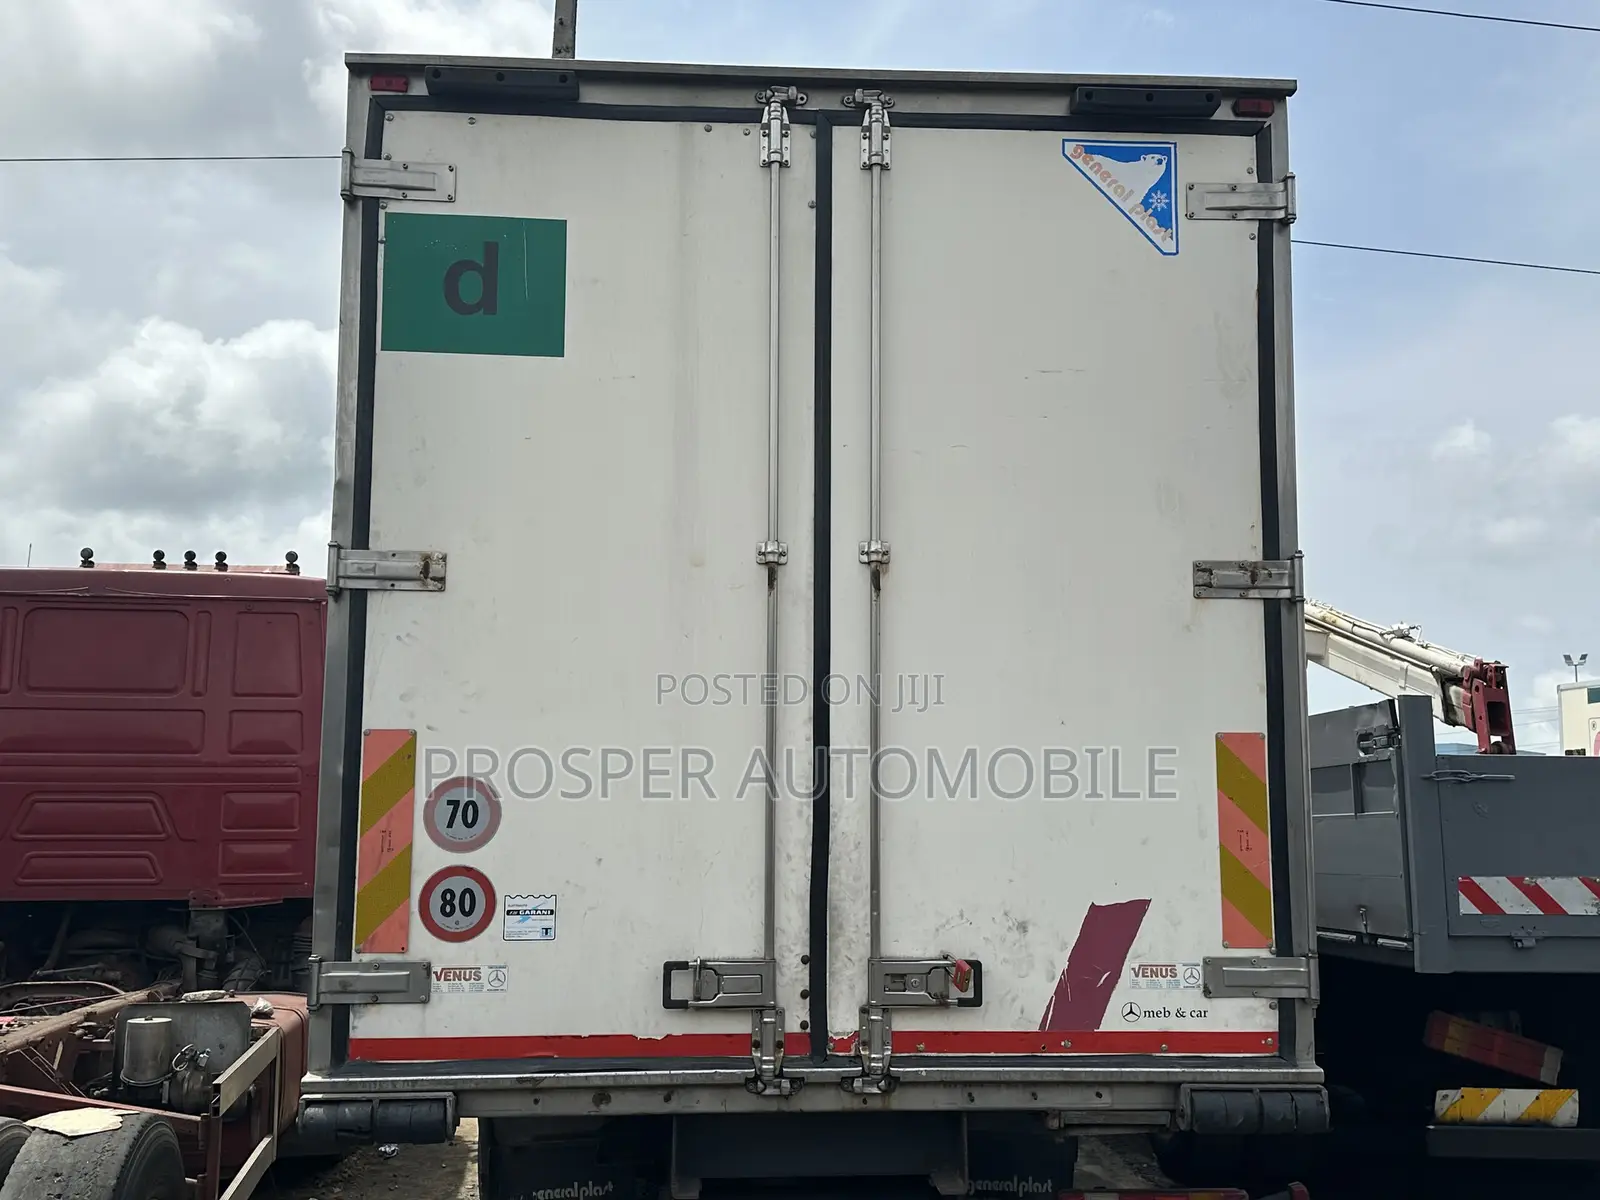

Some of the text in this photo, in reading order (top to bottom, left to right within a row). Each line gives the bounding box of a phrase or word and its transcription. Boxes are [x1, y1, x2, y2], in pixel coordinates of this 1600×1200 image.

[1070, 145, 1134, 203] general
[443, 241, 499, 316] d
[446, 799, 479, 829] 70
[439, 887, 477, 918] 80
[432, 966, 482, 982] VENUS
[1131, 964, 1178, 979] VENUS
[1143, 1006, 1209, 1019] meb & car
